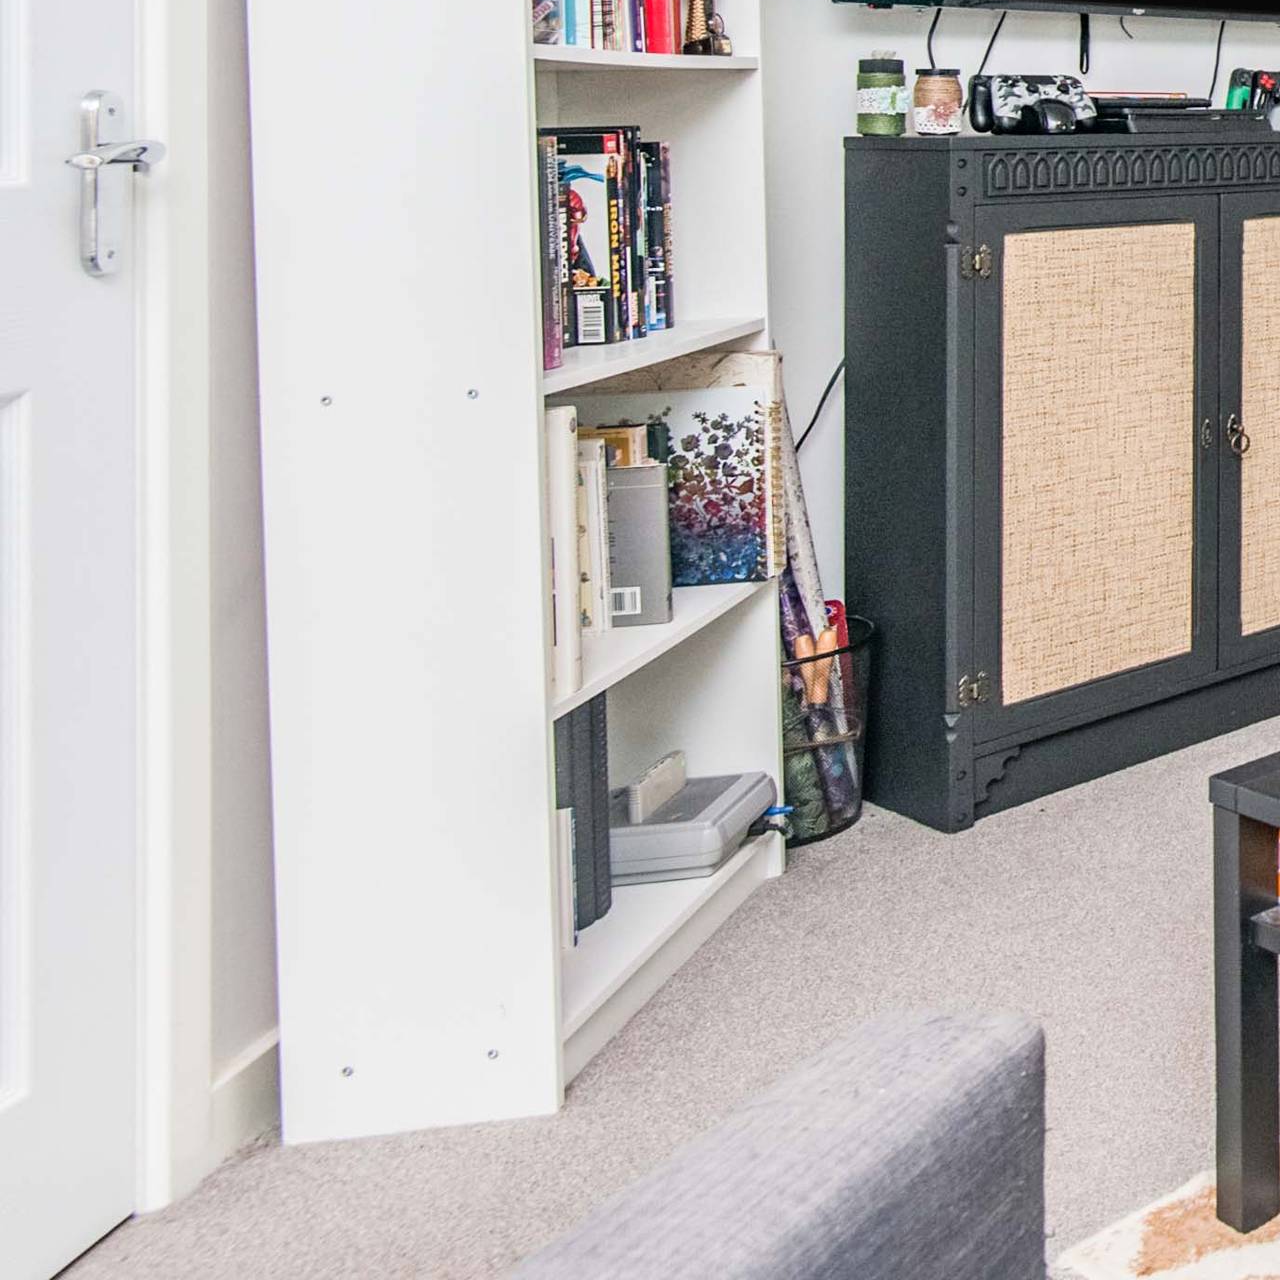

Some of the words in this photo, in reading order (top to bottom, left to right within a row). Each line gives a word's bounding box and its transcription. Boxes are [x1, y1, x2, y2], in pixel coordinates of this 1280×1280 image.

[610, 199, 619, 248] IRON
[612, 254, 621, 298] MAN
[631, 292, 639, 327] MARVEL
